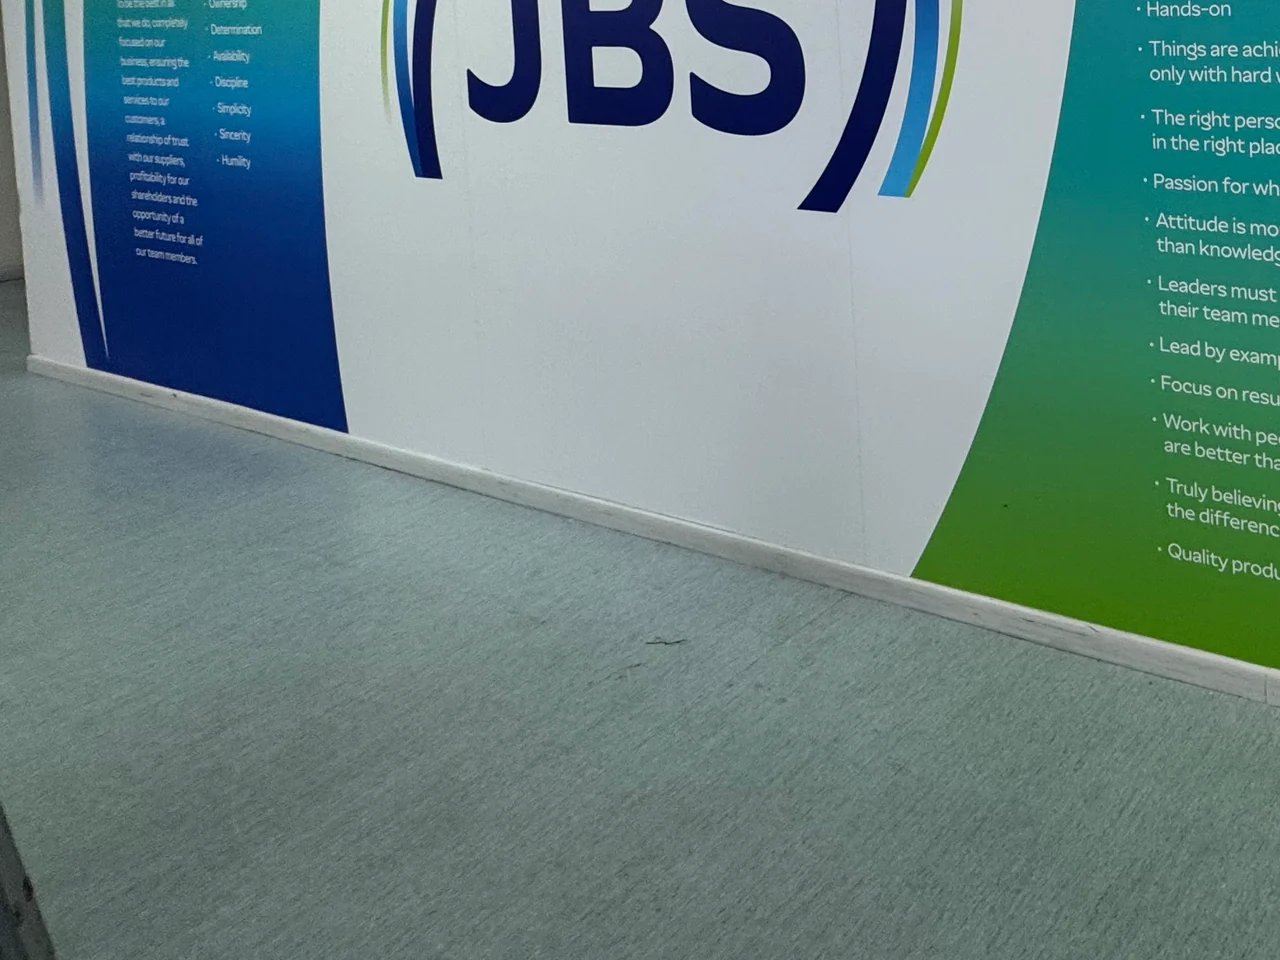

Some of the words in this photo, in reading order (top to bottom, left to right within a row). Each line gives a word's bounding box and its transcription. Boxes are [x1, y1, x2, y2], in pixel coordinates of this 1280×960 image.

[1147, 0, 1231, 17] Hands-on
[210, 24, 262, 35] Determination
[213, 50, 250, 64] Availability
[1148, 40, 1207, 61] Things
[1210, 45, 1238, 57] are
[215, 76, 249, 89] Discipline
[1149, 65, 1186, 85] only
[1188, 66, 1227, 82] with
[1231, 66, 1272, 83] hard
[217, 102, 251, 117] Simplicity
[1151, 108, 1186, 126] The
[1188, 110, 1231, 131] right
[219, 128, 251, 143] Sincerity
[1152, 133, 1167, 149] in
[1170, 134, 1200, 151] the
[1204, 136, 1245, 156] right
[221, 154, 250, 170] Humility
[1153, 173, 1218, 192] Passion
[1222, 177, 1250, 194] for
[1156, 212, 1229, 233] Attitude
[1233, 217, 1246, 234] is
[1156, 236, 1195, 254] than
[1158, 275, 1227, 297] Leaders
[1231, 286, 1277, 303] must
[1159, 300, 1199, 318] their
[1202, 306, 1247, 324] team
[1160, 336, 1201, 356] Lead
[1205, 341, 1226, 363] by
[1161, 375, 1212, 396] Focus
[1216, 387, 1238, 400] on
[1163, 413, 1210, 435] Work
[1213, 422, 1251, 441] with
[1164, 441, 1191, 455] are
[1195, 441, 1250, 465] better
[1166, 477, 1208, 502] Truly
[1166, 502, 1195, 521] the
[1168, 543, 1228, 572] Quality
